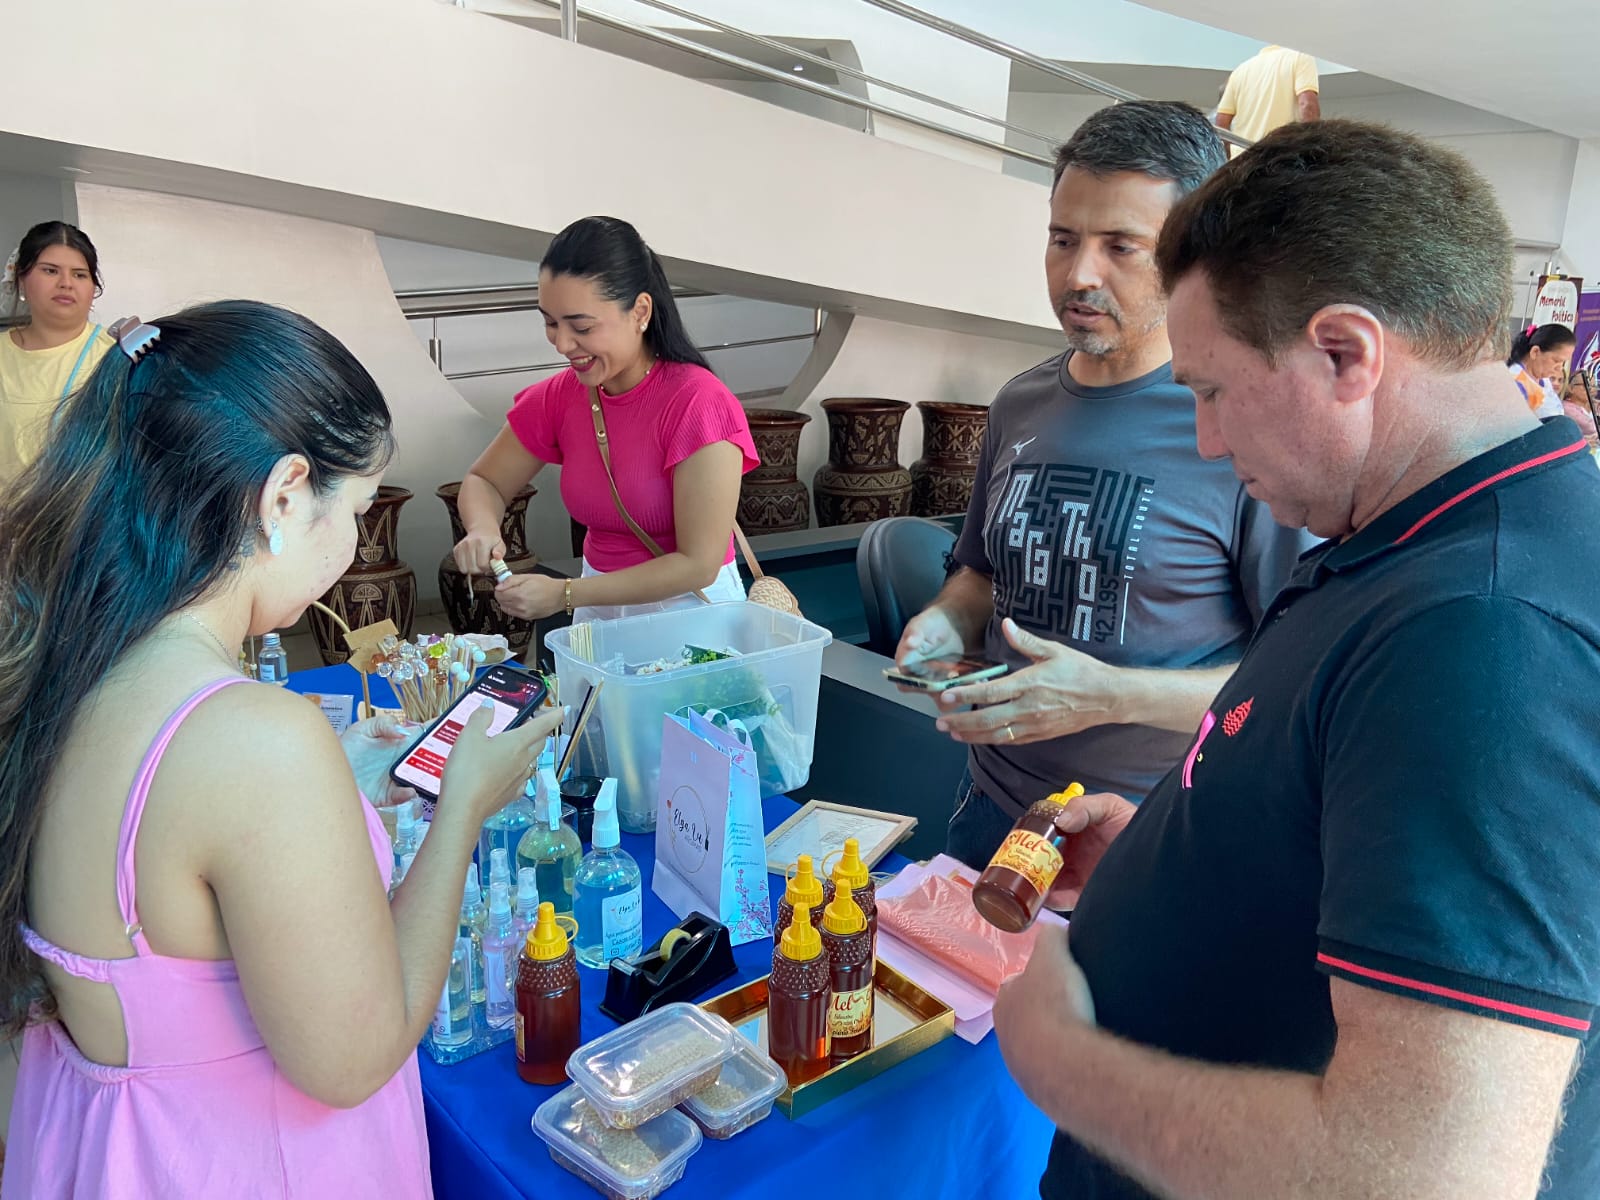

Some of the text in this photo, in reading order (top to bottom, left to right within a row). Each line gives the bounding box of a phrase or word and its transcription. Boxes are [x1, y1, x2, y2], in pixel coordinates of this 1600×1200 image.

[1123, 487, 1155, 579] TOTAL ROUTE
[1009, 832, 1043, 852] Mel
